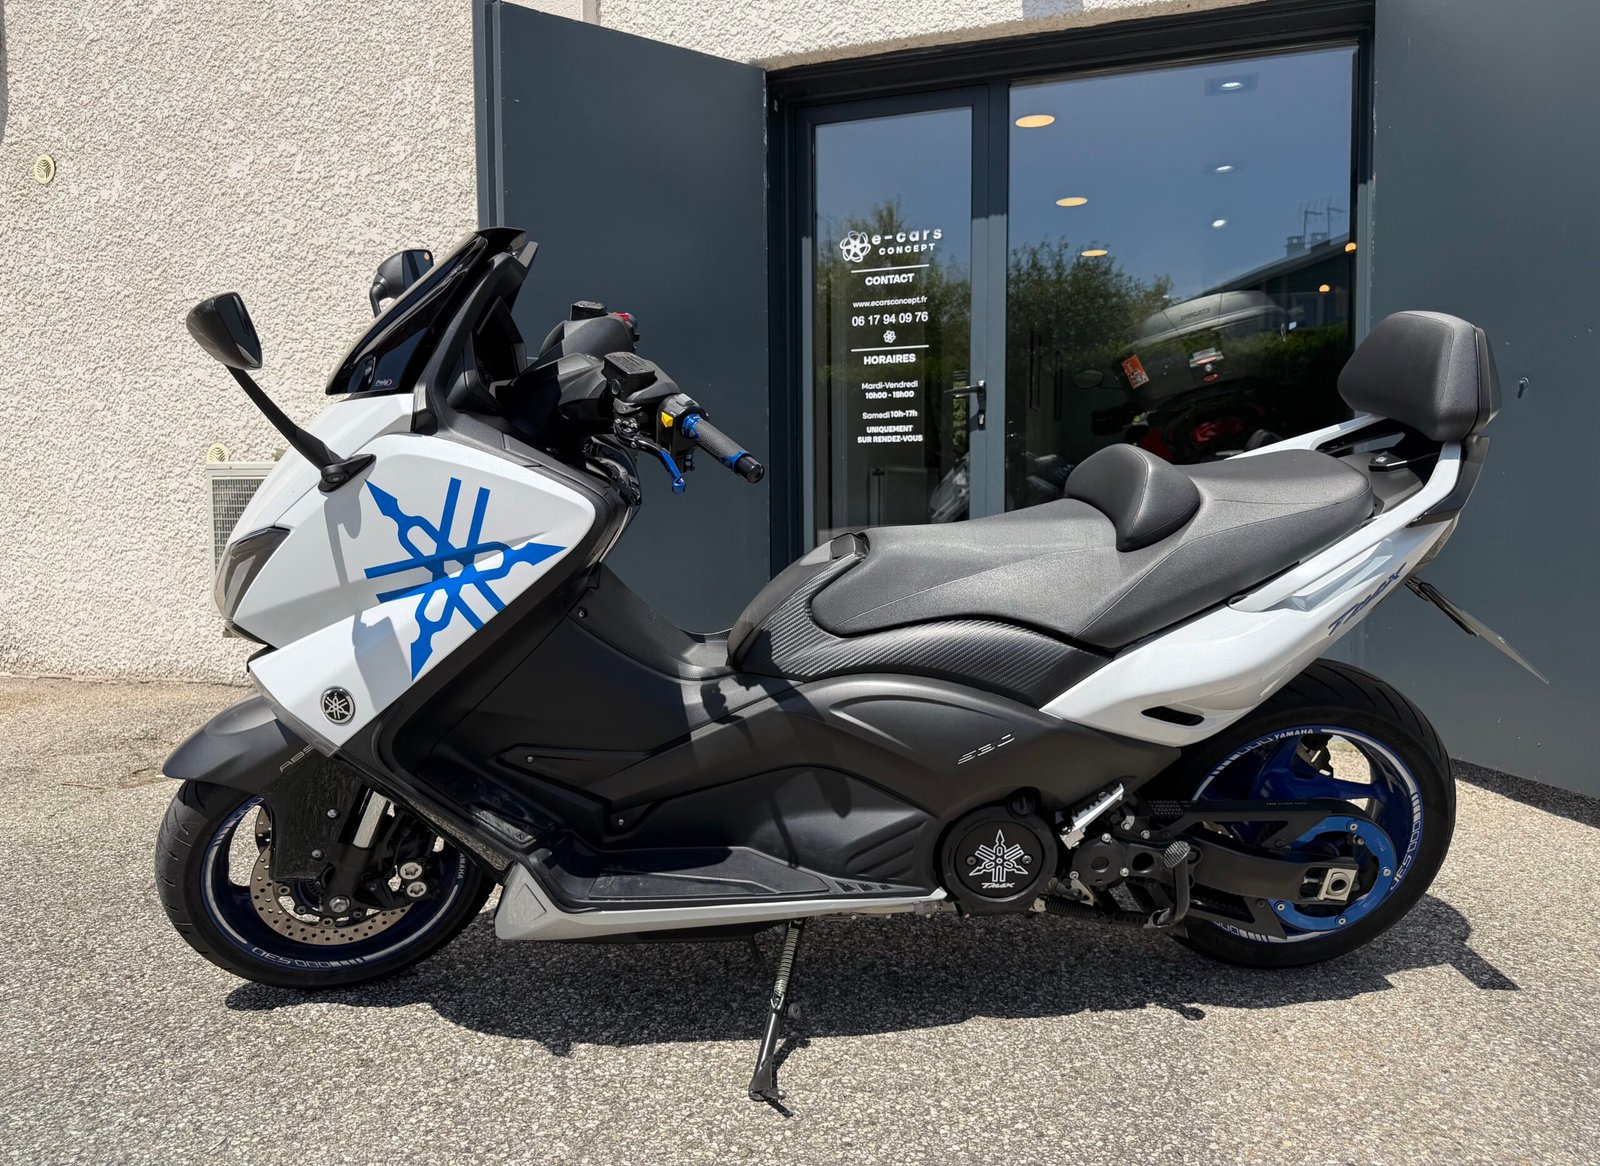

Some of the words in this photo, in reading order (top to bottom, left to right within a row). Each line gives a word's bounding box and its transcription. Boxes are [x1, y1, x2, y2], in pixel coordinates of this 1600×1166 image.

[872, 229, 942, 245] e-cars
[878, 243, 936, 255] CONCEPT
[864, 273, 915, 286] CONTACT
[852, 296, 928, 307] www.ecarsconcept.fr
[851, 316, 866, 327] 06
[868, 315, 881, 325] 17
[882, 314, 896, 325] 94
[898, 312, 913, 323] 09
[914, 311, 929, 322] 76
[863, 354, 916, 365] HORAIRES
[861, 381, 918, 389] Mardi-Vendredi
[865, 391, 888, 399] 10h00
[862, 411, 890, 419] Samedi
[866, 425, 914, 433] UNIQUEMENT
[857, 436, 872, 444] SUR
[872, 434, 924, 443] RENDEZ-VOUS
[1273, 728, 1315, 740] YAMAHA
[456, 852, 466, 880] AMAHA
